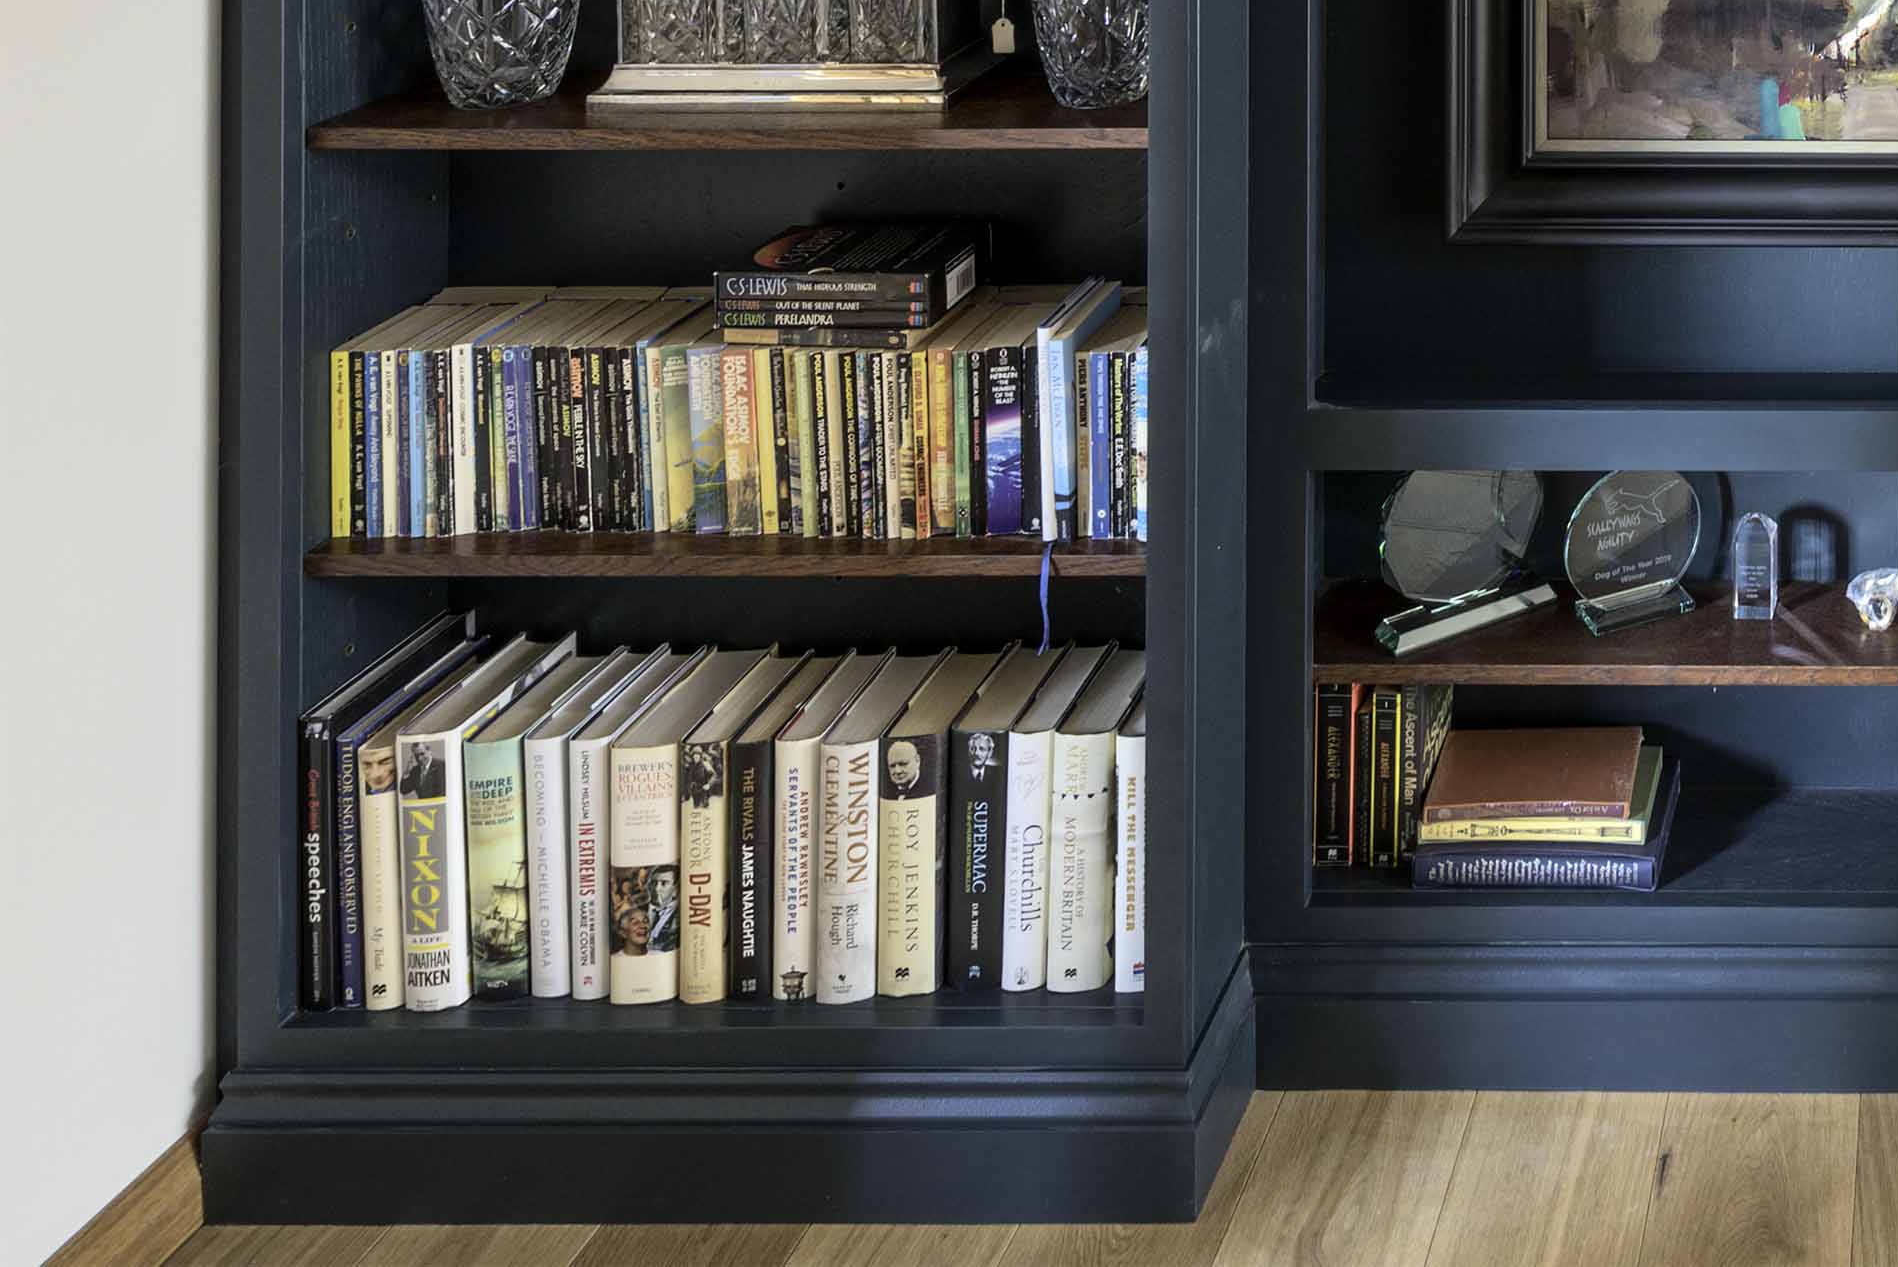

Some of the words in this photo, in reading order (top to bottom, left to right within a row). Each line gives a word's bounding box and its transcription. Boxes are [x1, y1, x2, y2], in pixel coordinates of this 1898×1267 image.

[1405, 713, 1418, 757] Ascent
[742, 768, 754, 794] THE
[1405, 760, 1417, 774] of
[788, 768, 798, 833] SERVANTS
[1405, 777, 1417, 806] Man
[578, 823, 594, 835] IN
[742, 796, 754, 840] RIVALS
[824, 756, 840, 884] CLEMENTINE
[847, 751, 869, 884] WINSTON
[904, 809, 919, 851] ROY
[579, 838, 595, 896] EXTREMIS
[788, 835, 798, 852] OF
[972, 801, 988, 894] SUPERMAC
[304, 833, 325, 923] speeches
[409, 809, 441, 931] NIXON
[742, 845, 754, 893] JAMES
[788, 856, 798, 882] THE
[888, 810, 901, 936] CHURCHILL
[1021, 824, 1044, 933] Churchills
[689, 873, 712, 927] D-DAY
[787, 887, 797, 934] PEOPLE
[904, 864, 919, 952] JENKINS
[742, 895, 754, 958] NAUGHTIE
[830, 905, 842, 946] Hough
[846, 904, 858, 950] Richard
[408, 950, 450, 968] JONATHAN
[408, 970, 450, 987] AITKEN
